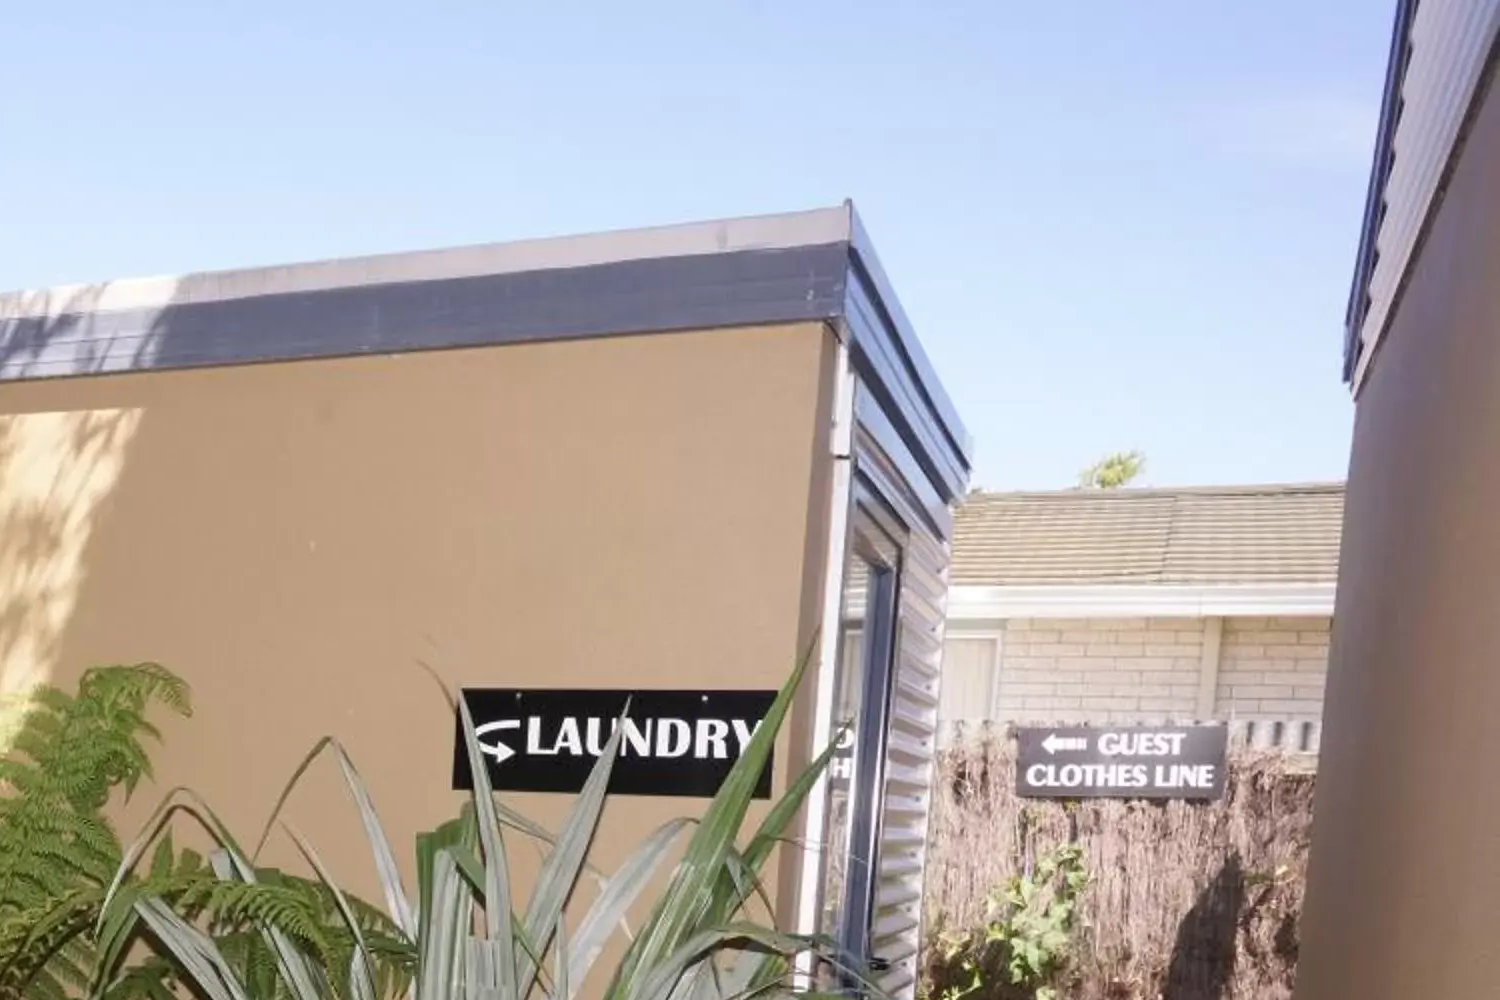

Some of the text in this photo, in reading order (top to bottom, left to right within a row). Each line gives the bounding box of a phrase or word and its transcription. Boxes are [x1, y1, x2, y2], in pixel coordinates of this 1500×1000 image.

[527, 716, 764, 759] LAUNDRY
[1097, 733, 1187, 756] GUEST
[1026, 763, 1216, 787] CLOTHES LINE
